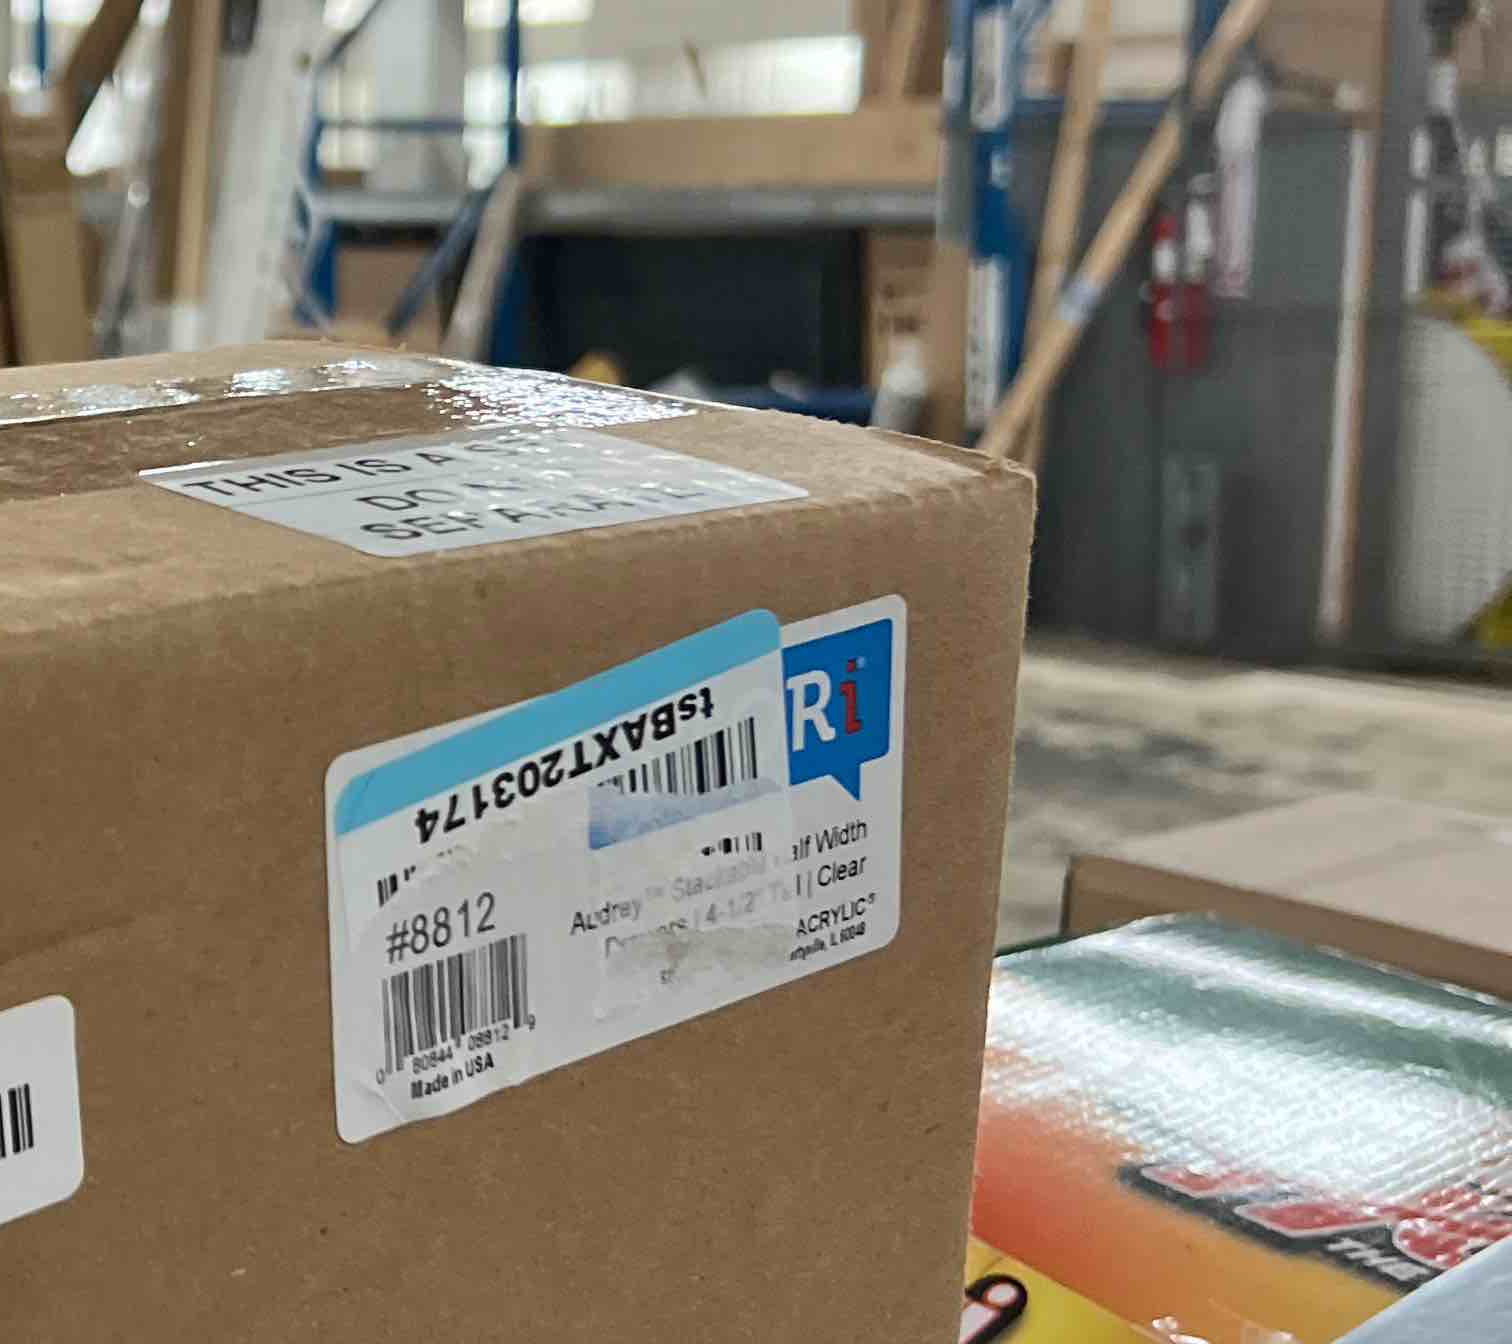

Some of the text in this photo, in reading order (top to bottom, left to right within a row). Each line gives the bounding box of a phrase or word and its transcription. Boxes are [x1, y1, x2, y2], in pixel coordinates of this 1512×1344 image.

[183, 467, 342, 498] THIS
[337, 458, 414, 478] IS
[414, 451, 455, 468] A
[354, 487, 464, 512] DO
[414, 686, 715, 844] tsBAXT203174
[815, 818, 868, 854] Width
[816, 855, 868, 888] Clear
[384, 891, 497, 964] #8812
[410, 1072, 450, 1100] Made
[464, 1051, 495, 1078] USA
